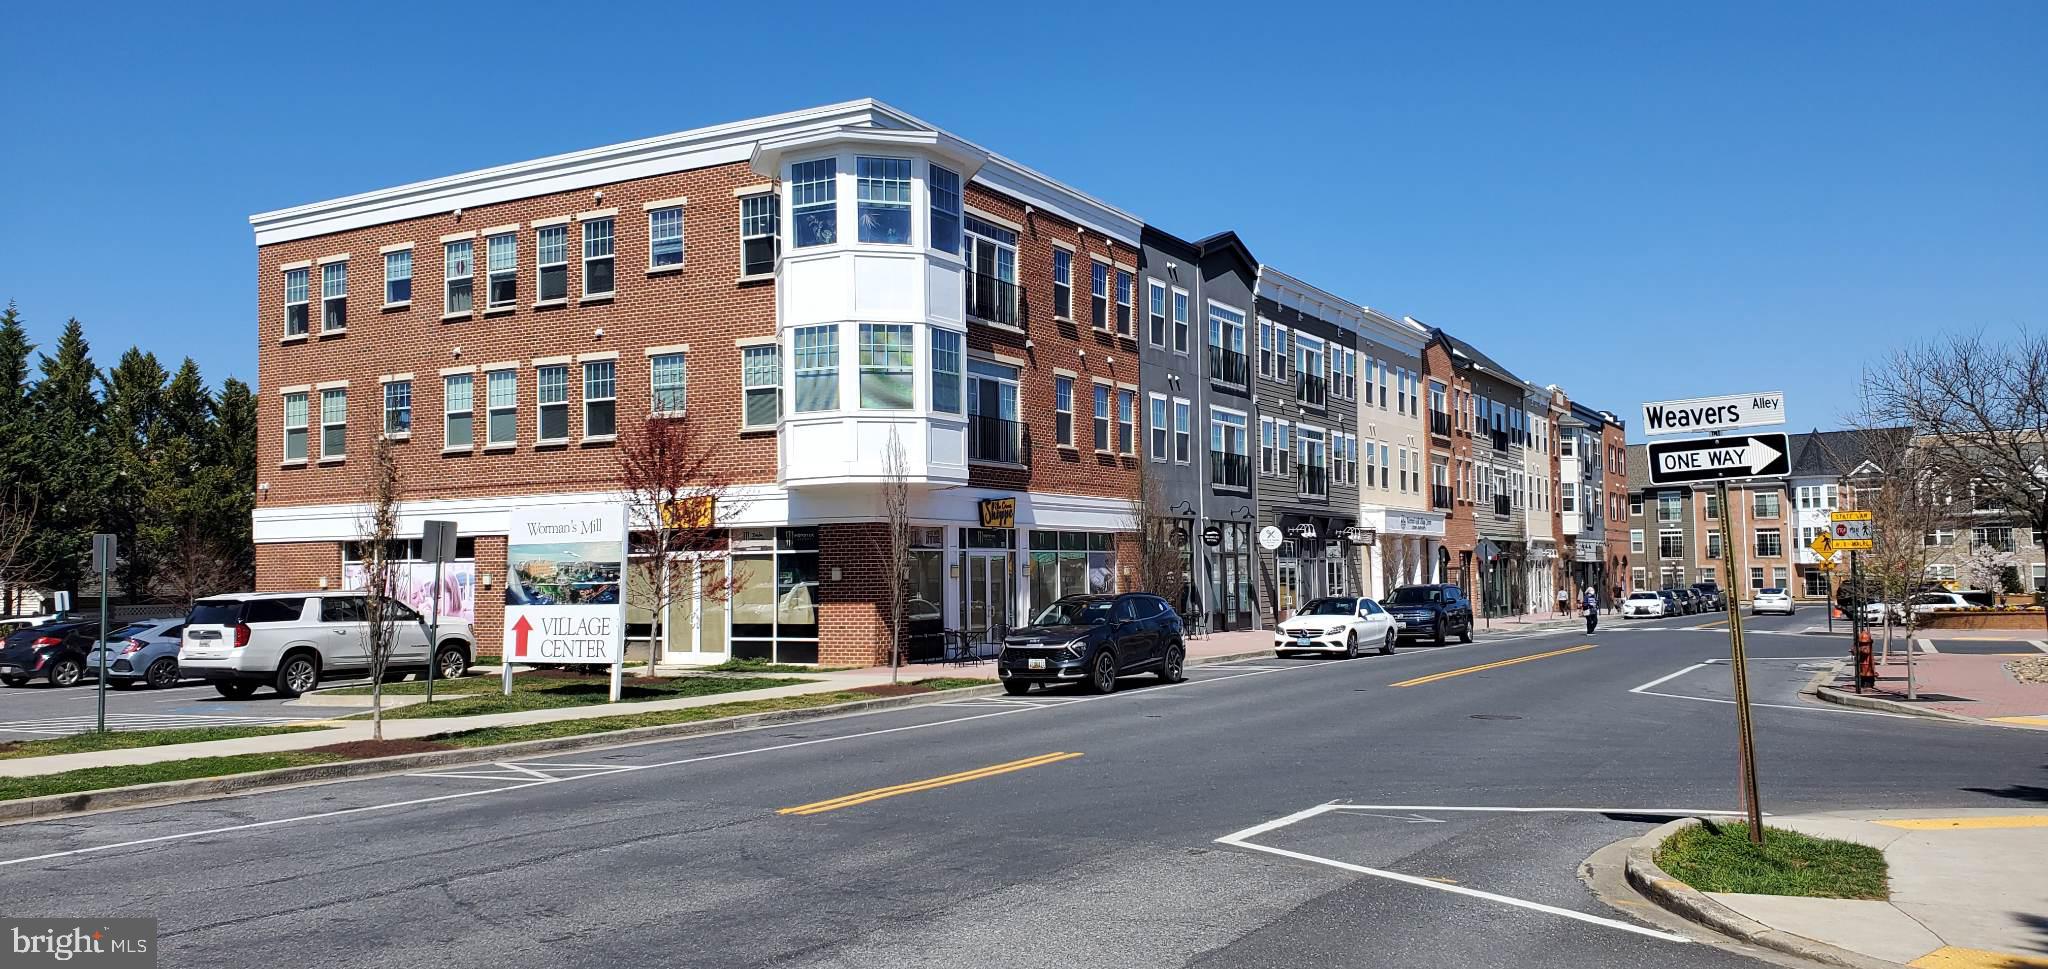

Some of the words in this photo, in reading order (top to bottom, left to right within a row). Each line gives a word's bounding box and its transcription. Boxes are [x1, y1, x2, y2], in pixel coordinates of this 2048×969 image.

[1646, 404, 1740, 429] Weavers
[1752, 397, 1779, 410] Alley
[1664, 452, 1702, 470] ONE
[1708, 449, 1745, 467] WAY
[527, 519, 577, 536] Worman's
[580, 518, 602, 534] Mill
[541, 617, 611, 635] VILLAGE
[540, 639, 607, 657] CENTER
